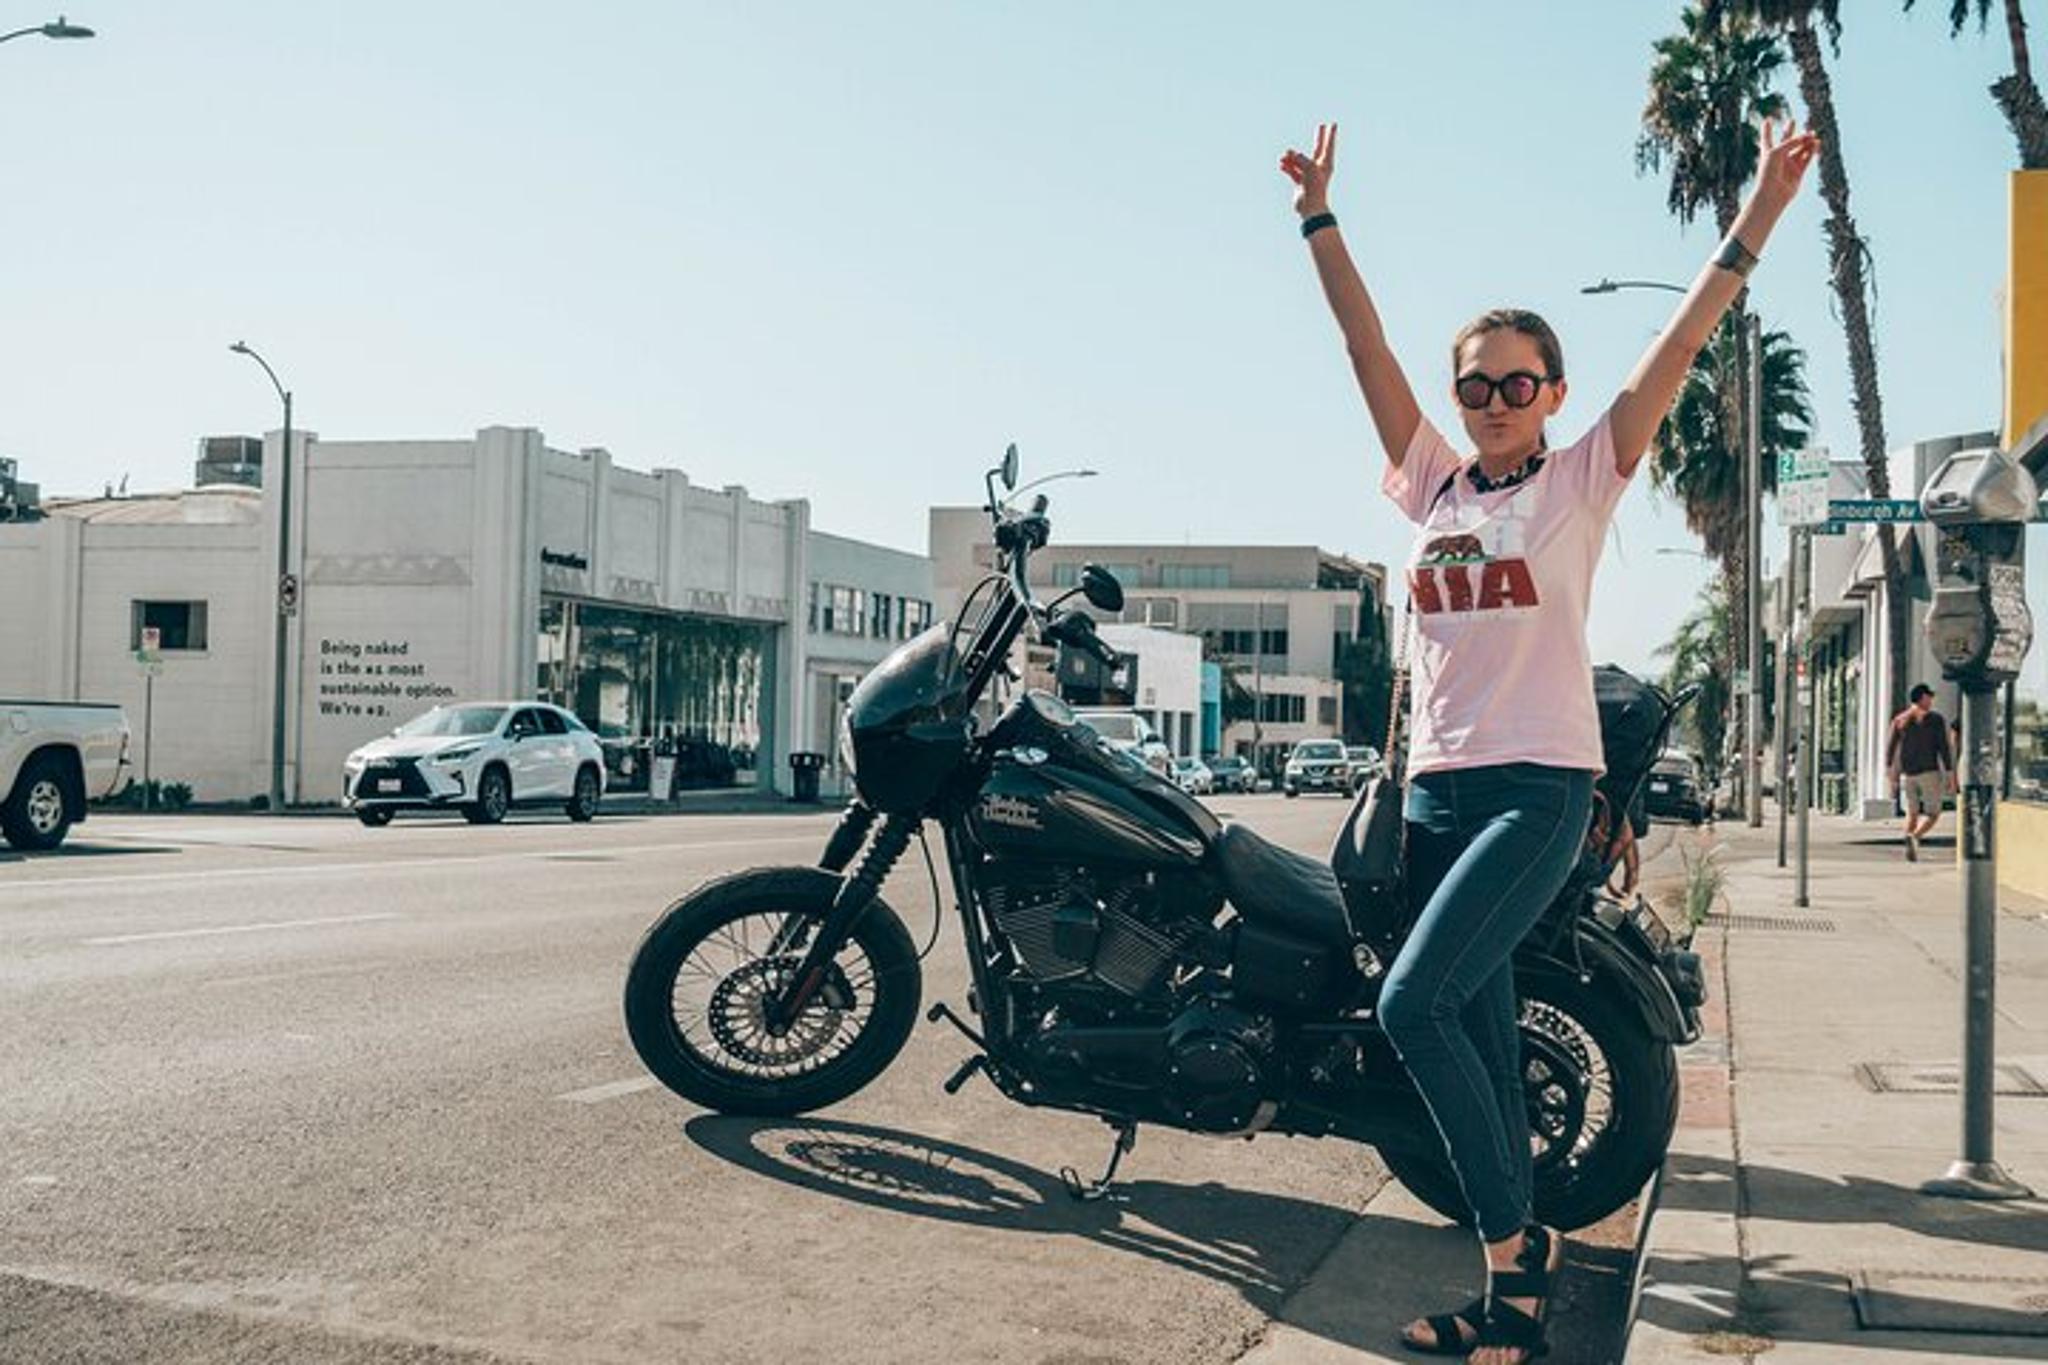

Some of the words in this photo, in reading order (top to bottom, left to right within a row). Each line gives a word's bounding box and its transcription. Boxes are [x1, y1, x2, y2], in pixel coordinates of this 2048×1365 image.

[321, 640, 361, 657] Being
[365, 640, 408, 654] naked
[321, 660, 332, 674] is
[338, 660, 360, 674] the
[387, 664, 424, 675] most
[321, 681, 401, 695] sustainable
[406, 682, 457, 699] option.
[320, 701, 361, 714] We're
